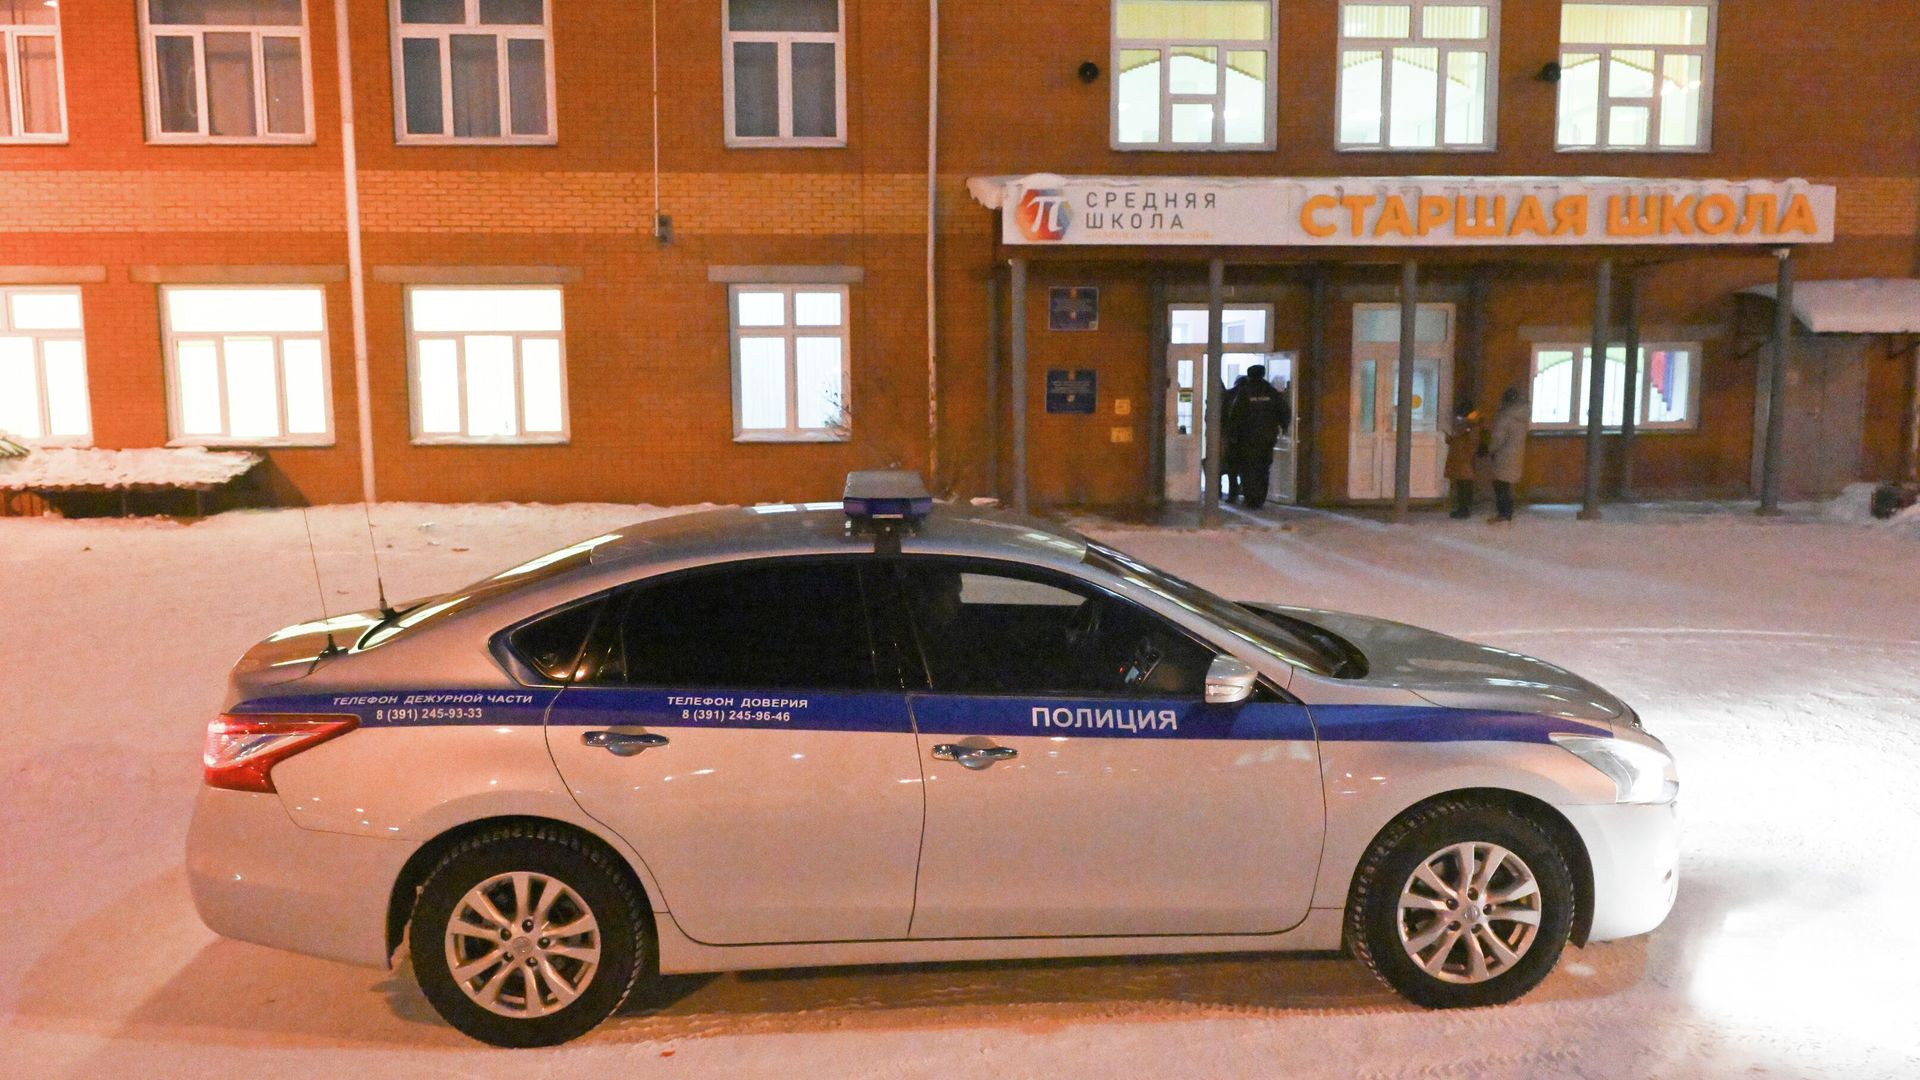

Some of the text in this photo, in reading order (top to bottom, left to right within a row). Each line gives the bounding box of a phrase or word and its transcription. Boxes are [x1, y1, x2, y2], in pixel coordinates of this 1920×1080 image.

[1086, 192, 1216, 211] СРЕДНЯЯ
[1086, 213, 1183, 230] ШКОЛА
[1300, 193, 1819, 237] СТАРШАЯ ШКОЛА
[333, 694, 533, 706] ТЕЛЕФОН ДЕЖУРНОЙ ЧАСТИ
[667, 697, 808, 709] ТЕЛЕФОН ДОВЕРИЯ
[376, 708, 482, 722] 8 (391) 245-93-33
[682, 709, 791, 722] 8 (391) 245-96-46
[1031, 707, 1178, 733] ПОЛИЦИЯ
